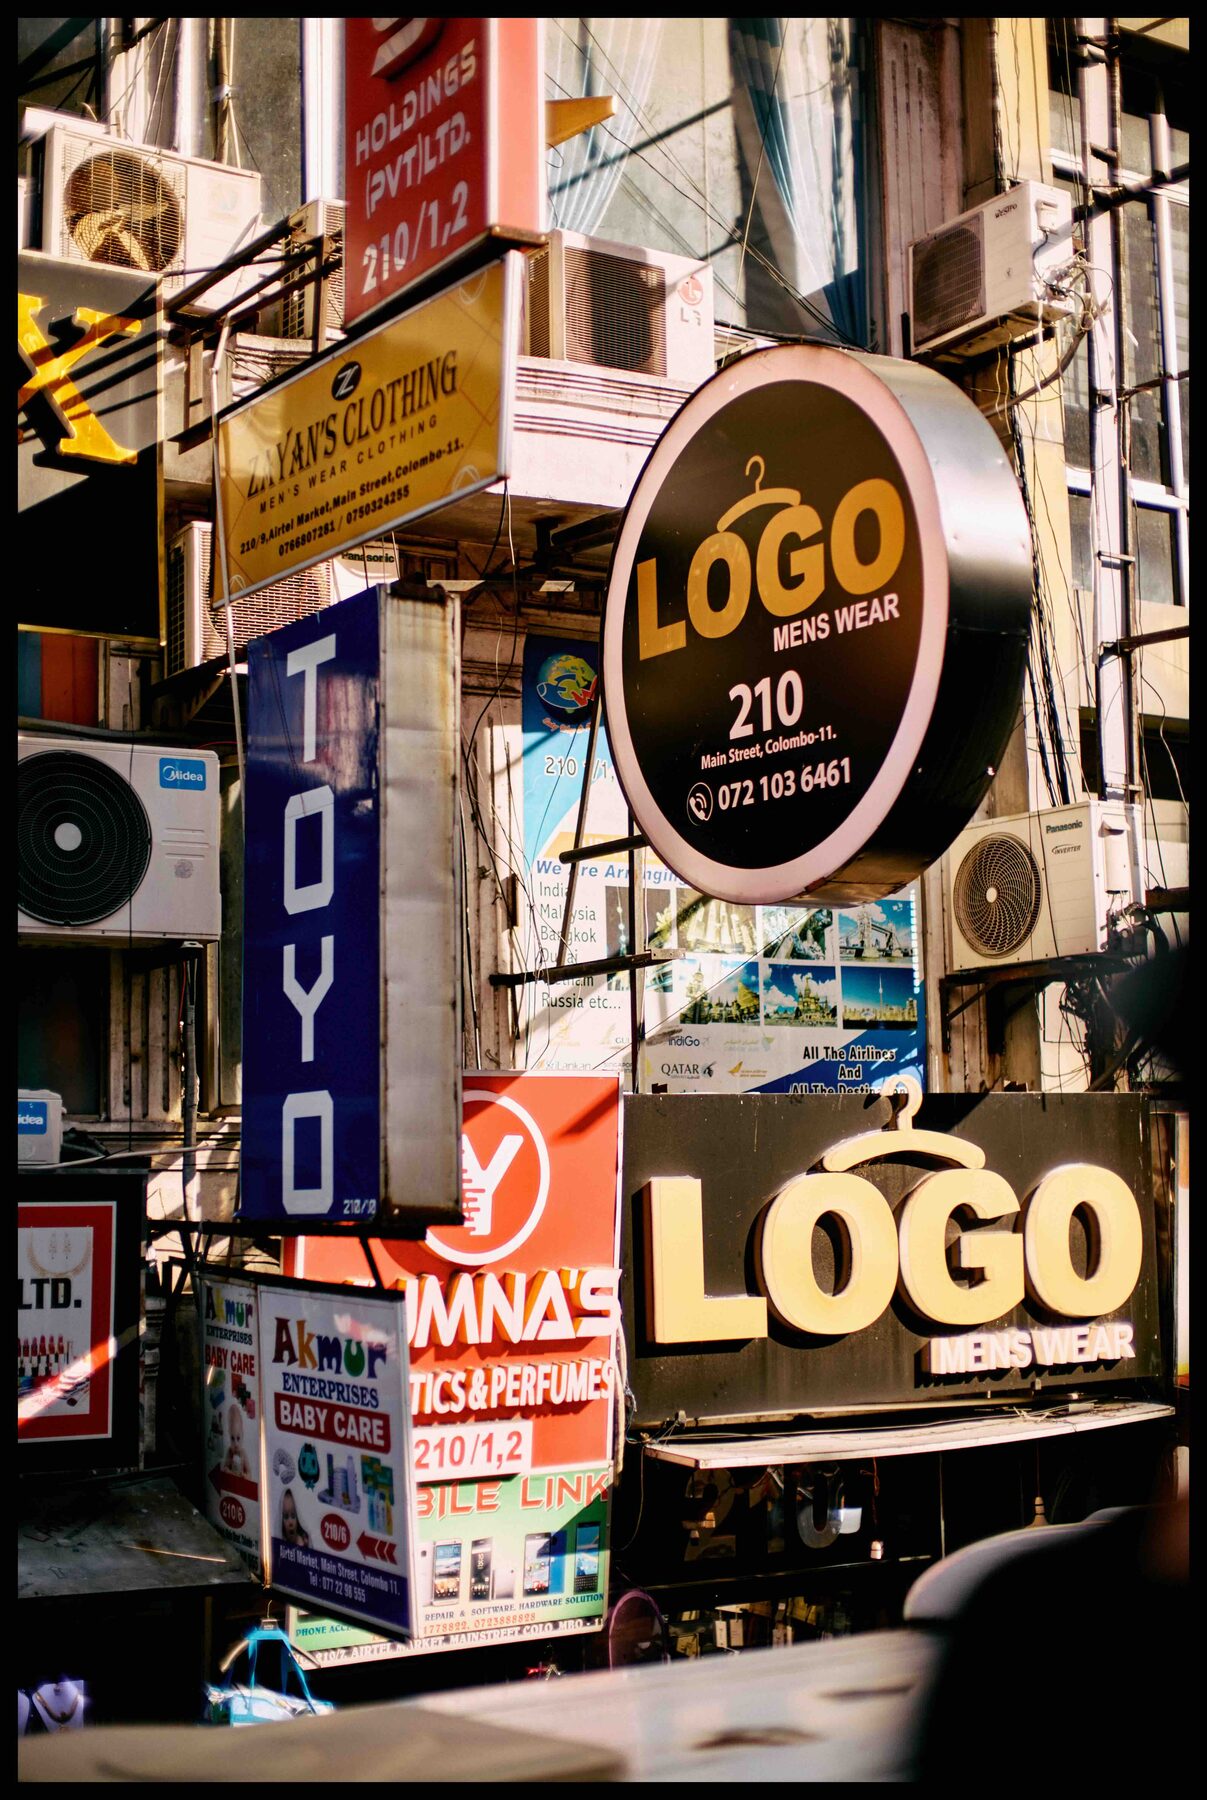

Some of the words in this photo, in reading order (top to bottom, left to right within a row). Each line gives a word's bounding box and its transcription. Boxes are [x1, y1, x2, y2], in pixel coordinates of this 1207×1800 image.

[355, 39, 476, 167] HOLDINGS
[362, 180, 469, 295] 210/1,2
[246, 412, 338, 498] ZAYAN'S
[343, 350, 457, 447] CLOTHING
[259, 484, 300, 514] MEN'S
[308, 460, 347, 489] WEAR
[357, 414, 437, 465] CLOTHING
[636, 478, 905, 661] LOGO
[772, 612, 831, 652] MENS
[833, 592, 900, 635] WEAR
[728, 669, 804, 740] 210
[701, 752, 727, 770] Main
[728, 742, 764, 764] Street,
[764, 725, 838, 755] Colombo-11.
[169, 767, 204, 782] Midea
[544, 756, 578, 778] 210
[717, 779, 755, 811] 072
[759, 769, 796, 801] 103
[800, 756, 851, 793] 6461
[1045, 819, 1083, 834] Panasonic
[537, 860, 562, 876] We
[282, 632, 337, 1215] TOYO
[540, 903, 597, 924] Malysia
[541, 946, 579, 965] Duai
[541, 991, 584, 1009] Russia
[661, 1063, 700, 1077] QATAR
[802, 1046, 819, 1061] All
[823, 1046, 846, 1061] The
[849, 1045, 897, 1061] Airlines
[838, 1065, 863, 1079] And
[645, 1163, 1144, 1343] LOGO
[18, 1277, 83, 1310] LTD.
[205, 1324, 253, 1346] ENTERPRISES
[271, 1316, 388, 1380] Akmur
[930, 1327, 1033, 1375] MENS
[1031, 1323, 1137, 1367] WEAR
[204, 1343, 228, 1370] BABY
[230, 1350, 256, 1377] CARE
[281, 1371, 380, 1410] ENTERPRISES
[279, 1399, 328, 1434] BABY
[333, 1410, 386, 1447] CARE
[520, 1472, 609, 1511] LINK
[323, 1521, 348, 1544] 210/6
[308, 1571, 318, 1587] Tel
[320, 1558, 338, 1575] Main
[360, 1570, 389, 1592] Colombo
[424, 1610, 455, 1622] REPAIR
[459, 1609, 466, 1618] &
[518, 1598, 564, 1611] HARDWARE
[565, 1593, 605, 1605] SOLUTION
[295, 1625, 328, 1638] PHONE
[350, 1643, 394, 1659] AIRTEL
